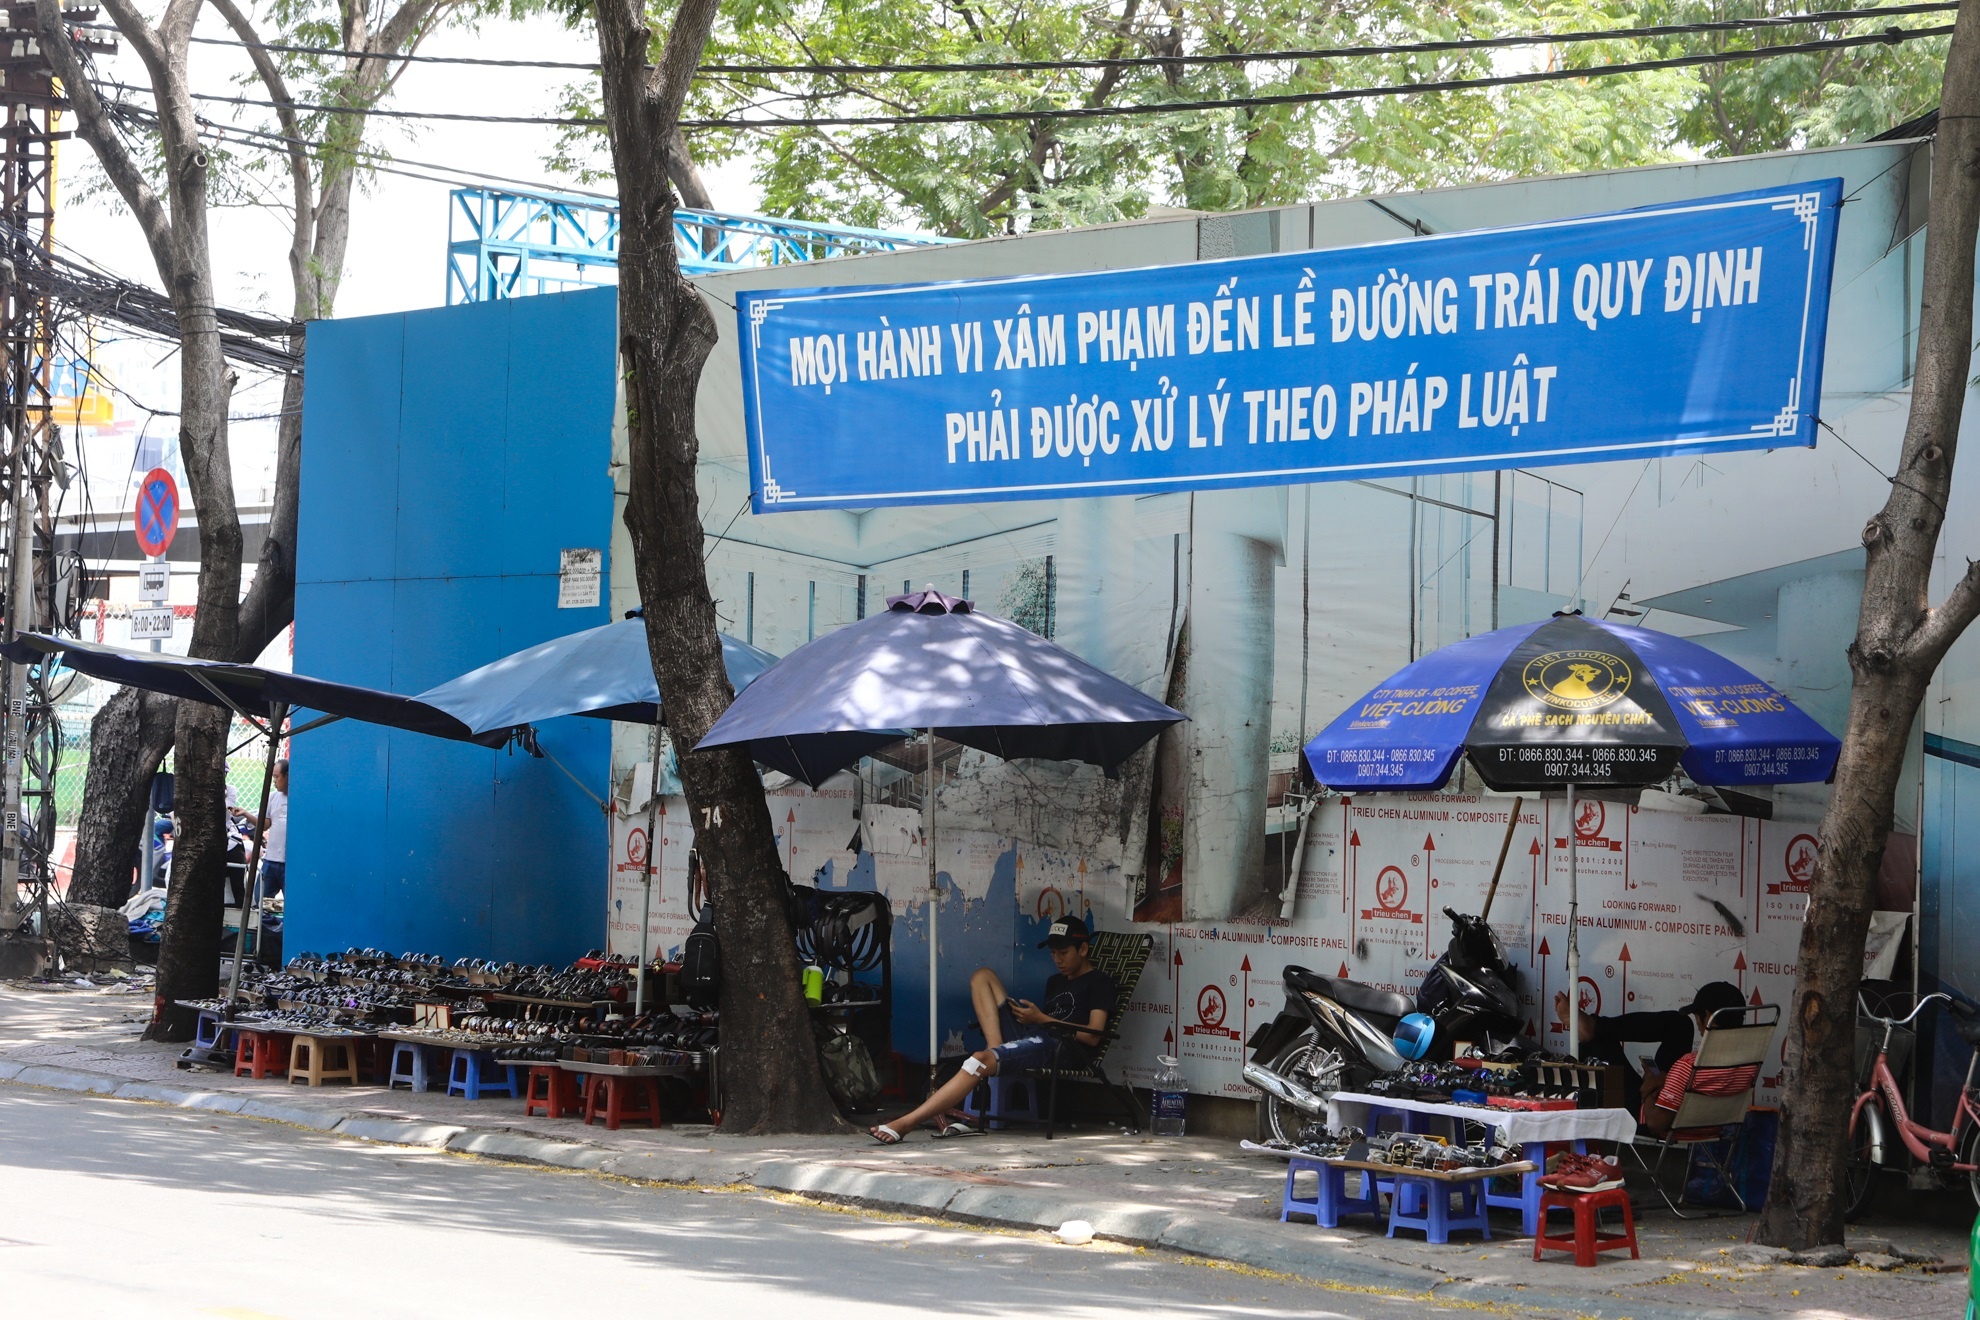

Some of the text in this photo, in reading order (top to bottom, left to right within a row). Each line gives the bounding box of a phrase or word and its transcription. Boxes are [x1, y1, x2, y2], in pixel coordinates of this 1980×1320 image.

[790, 246, 1763, 395] MỌI HÀNH VI XÂM PHẠM ĐẾN LỀ ĐƯỜNG TRÁI QUY ĐỊNH
[945, 353, 1557, 467] PHẢI ĐƯỢC XỬ LÝ THEO PHÁP LUẬT
[134, 615, 170, 632] 6:00 22:00
[1373, 690, 1391, 699] CTY
[1391, 689, 1415, 699] TNHH
[1445, 685, 1480, 696] COFFEE
[1737, 684, 1768, 694] COFFEE
[1542, 690, 1616, 708] VINKOCOFFEE
[1520, 713, 1543, 726] PHÊ
[1545, 714, 1574, 729] SẠCH
[1576, 711, 1621, 725] NGUYÊN
[1327, 749, 1435, 763] ĐT: 0866.830.344 0866.830.345
[1499, 749, 1657, 762] ĐT: 0866.830.344 0866.830.345
[1715, 748, 1819, 763] ĐT: 0866.830.344 0866.830.345
[1358, 764, 1404, 777] 0907.344.345
[1544, 763, 1611, 777] 0907.344.345
[1744, 762, 1788, 776] 0907.344.345
[1441, 795, 1476, 804] FORWARD
[7, 813, 16, 830] BNE
[701, 805, 723, 830] 74
[1352, 806, 1540, 825] TRIEU CHEN ALUMINIUM COMPOSITE ANEL
[1587, 838, 1606, 847] chen
[1783, 883, 1803, 892] trieu
[1602, 900, 1677, 913] LOOKING FORWARD
[1766, 902, 1782, 910] ISO
[648, 911, 666, 919] OOKING
[1392, 911, 1408, 919] chen
[1257, 918, 1290, 927] FORWARD
[1541, 913, 1567, 925] TRIEU
[1576, 915, 1594, 928] HEN
[1596, 917, 1647, 932] ALUMINIUM
[1655, 921, 1711, 935] COMPOSITE
[647, 925, 672, 935] LUMINIUM
[1175, 927, 1348, 950] TRIEU CHEN ALUMINIUM COMPOSITE PANEL
[1752, 962, 1780, 975] TRIEU
[1374, 981, 1397, 993] CHEN
[1149, 1003, 1173, 1014] PANEL
[1195, 1026, 1228, 1036] trieu chen
[1223, 1083, 1253, 1094] LOOKING
